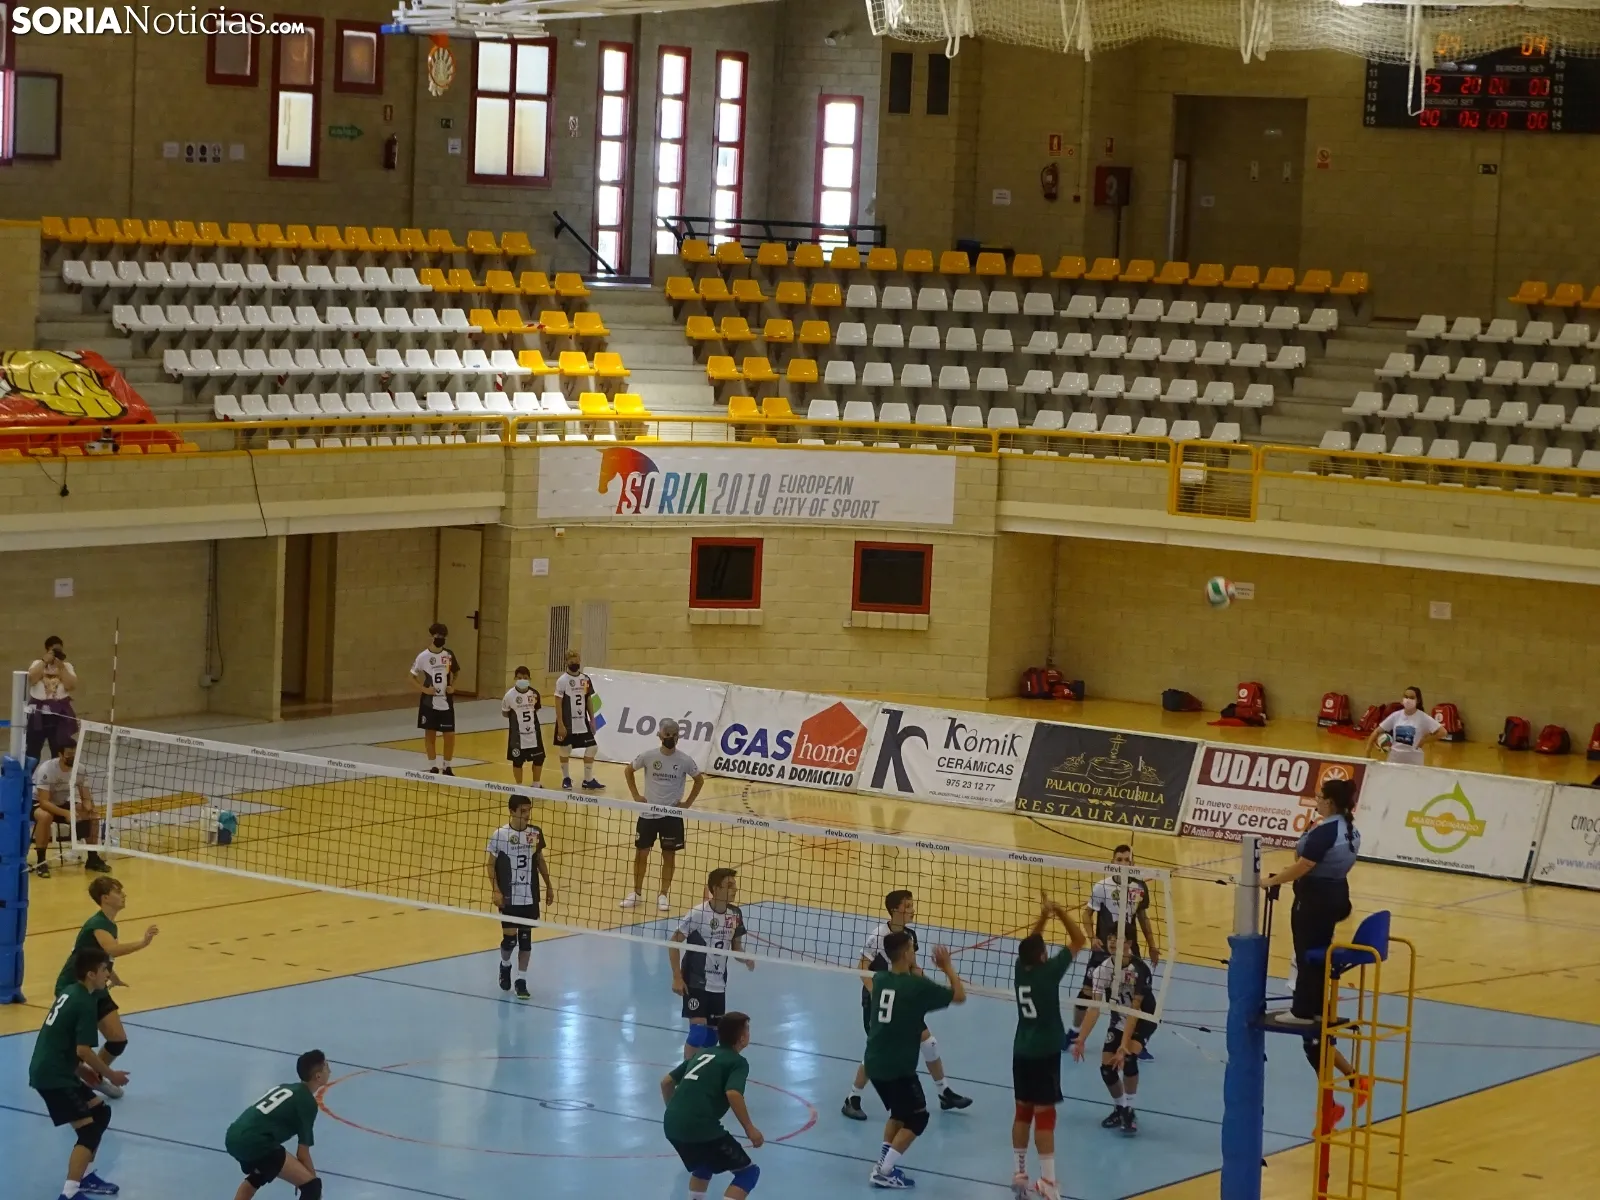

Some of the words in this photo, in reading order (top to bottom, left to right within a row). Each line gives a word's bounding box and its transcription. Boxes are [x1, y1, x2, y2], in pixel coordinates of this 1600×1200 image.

[620, 471, 708, 515] SORIA
[712, 472, 772, 516] 2019
[778, 473, 855, 496] EUROPEAN
[772, 496, 806, 517] CITY
[808, 498, 828, 517] OF
[831, 499, 880, 519] SPORT
[434, 672, 443, 684] 6
[575, 694, 582, 706] 2
[522, 711, 531, 723] 5
[617, 707, 715, 743] Loán
[720, 722, 796, 761] GAS
[797, 734, 858, 766] home
[713, 756, 774, 779] GASOLEOS
[775, 765, 786, 780] A
[788, 766, 855, 788] DOMICILIO
[946, 778, 961, 788] 975
[961, 781, 972, 789] 23
[974, 783, 984, 791] 12
[985, 783, 996, 792] 77
[1209, 751, 1310, 793] UDACO
[176, 737, 204, 747] rfevb.com
[250, 748, 280, 758] rfevb.com
[327, 759, 356, 769] rfevb.com
[405, 770, 435, 781] rfevb.com
[485, 782, 516, 793] rfevb.com
[567, 793, 598, 804] rfevb.com
[650, 805, 683, 816] rfevb.com
[737, 817, 770, 828] rfevb.com
[825, 828, 859, 840] rfevb.com
[915, 840, 950, 852] rfevb.com
[1008, 852, 1044, 863] rfevb.com
[1045, 778, 1091, 794] PALACIO
[1104, 786, 1165, 805] ALCUBILLA
[1017, 797, 1175, 831] RESTAURANTE
[1192, 807, 1233, 828] muy
[1237, 813, 1289, 832] cerca
[1195, 797, 1205, 806] Tu
[1206, 800, 1232, 809] nuevo
[1233, 802, 1292, 816] supermercado
[1275, 837, 1283, 846] al
[1282, 840, 1298, 848] cuar
[517, 854, 527, 869] 3
[45, 993, 69, 1026] 3
[878, 988, 896, 1024] 9
[1018, 985, 1037, 1019] 5
[684, 1053, 716, 1081] 2
